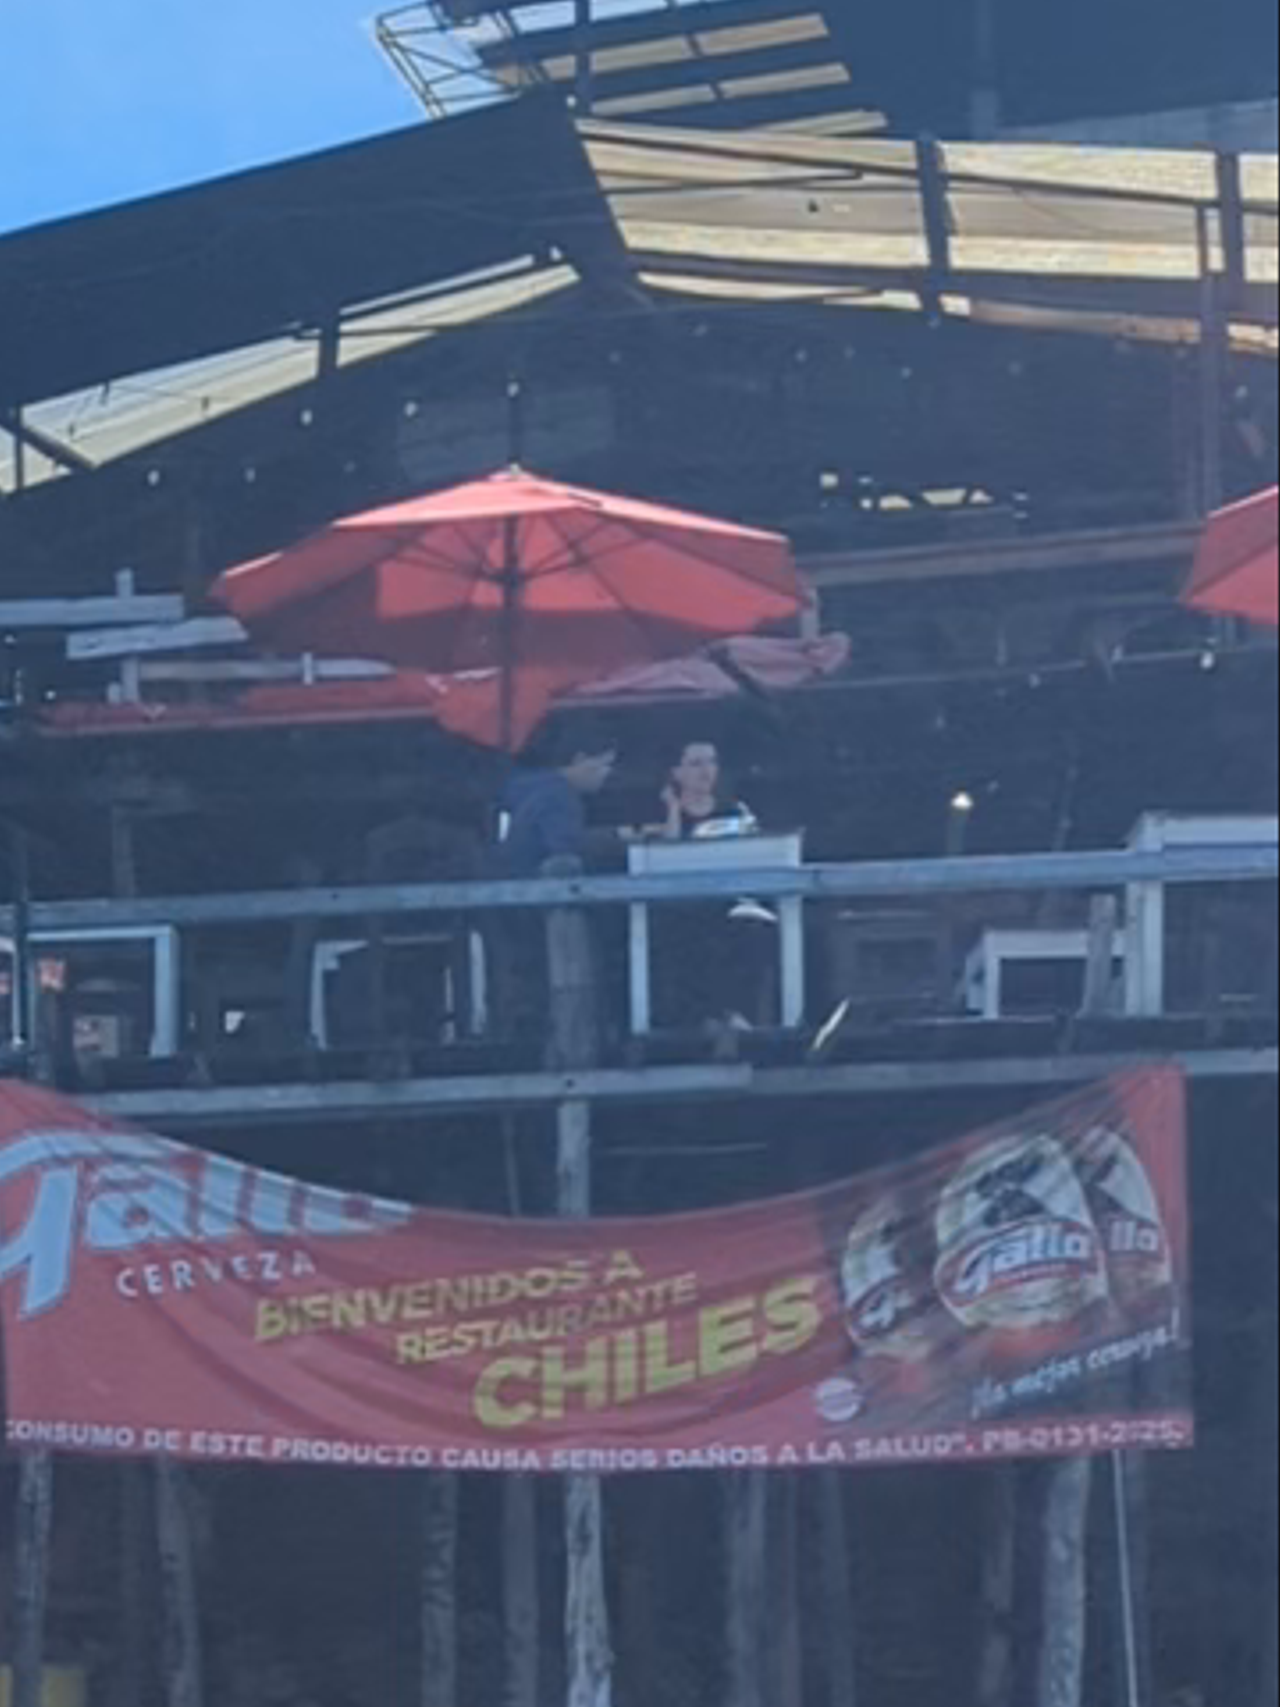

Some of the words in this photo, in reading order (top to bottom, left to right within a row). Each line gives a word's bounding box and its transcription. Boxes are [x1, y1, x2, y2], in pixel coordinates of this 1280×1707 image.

[115, 1249, 317, 1298] CERVEZA
[254, 1259, 590, 1344] BIENVENIDOS
[606, 1249, 645, 1286] A
[395, 1271, 698, 1365] RESTAURANTE
[473, 1274, 824, 1429] CHILES
[143, 1428, 180, 1452] DE
[190, 1431, 264, 1459] ESTE
[272, 1437, 431, 1468] PRODUCTO
[441, 1446, 541, 1471] CAUSA
[549, 1448, 658, 1471] SERIOS
[667, 1439, 770, 1470] DAÑOS
[777, 1443, 801, 1466] A
[807, 1440, 847, 1465] LA
